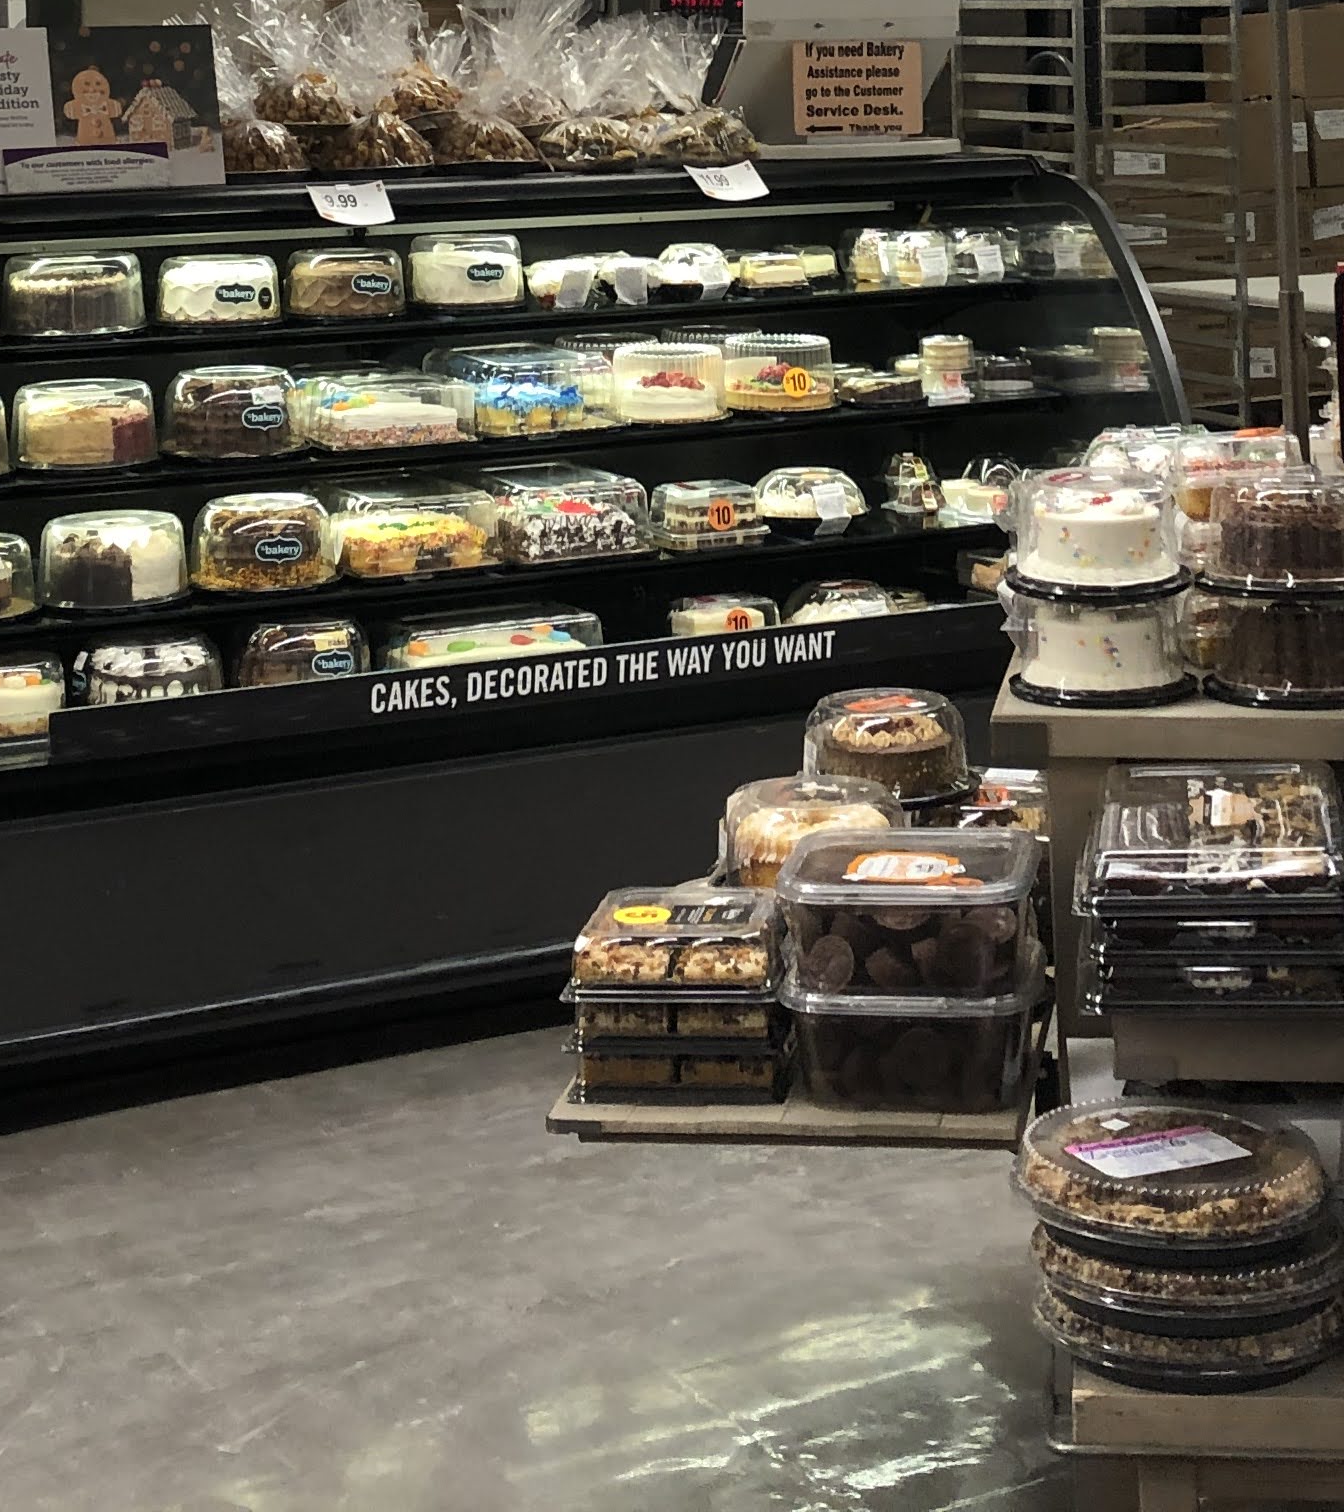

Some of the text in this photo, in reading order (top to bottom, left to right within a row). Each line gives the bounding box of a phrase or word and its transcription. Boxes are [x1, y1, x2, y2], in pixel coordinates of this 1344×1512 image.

[816, 44, 835, 62] you
[837, 41, 864, 58] need
[866, 41, 904, 61] Bakery
[807, 64, 901, 80] Assistance please
[805, 84, 904, 100] go to the Customer
[806, 102, 904, 118] Service Desk.
[370, 630, 836, 715] CAKES, DECORATED THE WAY YOU WANT
